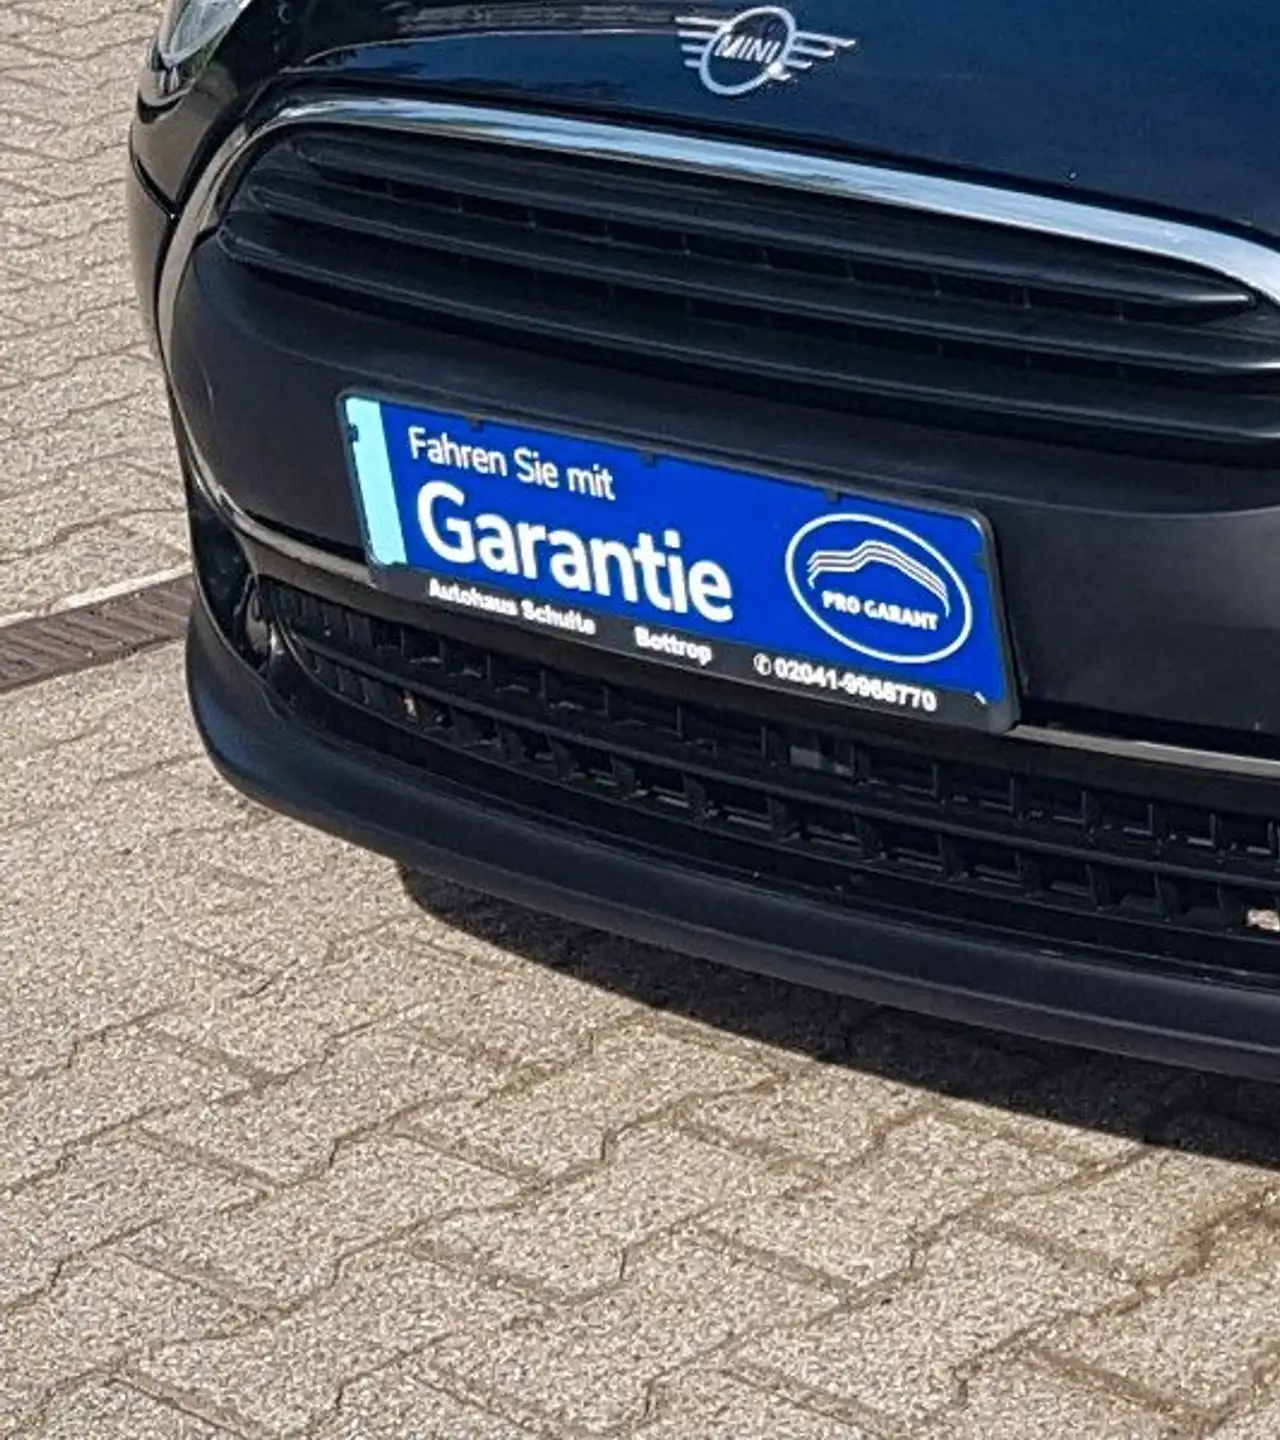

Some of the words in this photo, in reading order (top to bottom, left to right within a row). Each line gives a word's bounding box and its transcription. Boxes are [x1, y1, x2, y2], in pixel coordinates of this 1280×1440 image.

[713, 34, 781, 64] MINI
[408, 425, 508, 477] Fahren
[514, 446, 560, 489] Sie
[566, 463, 616, 501] mit
[417, 480, 733, 622] Garantie
[429, 577, 518, 616] Autohaus
[521, 599, 596, 635] Schulte
[634, 626, 713, 666] Bottrop
[821, 589, 861, 615] PRO
[864, 599, 939, 632] GARANT
